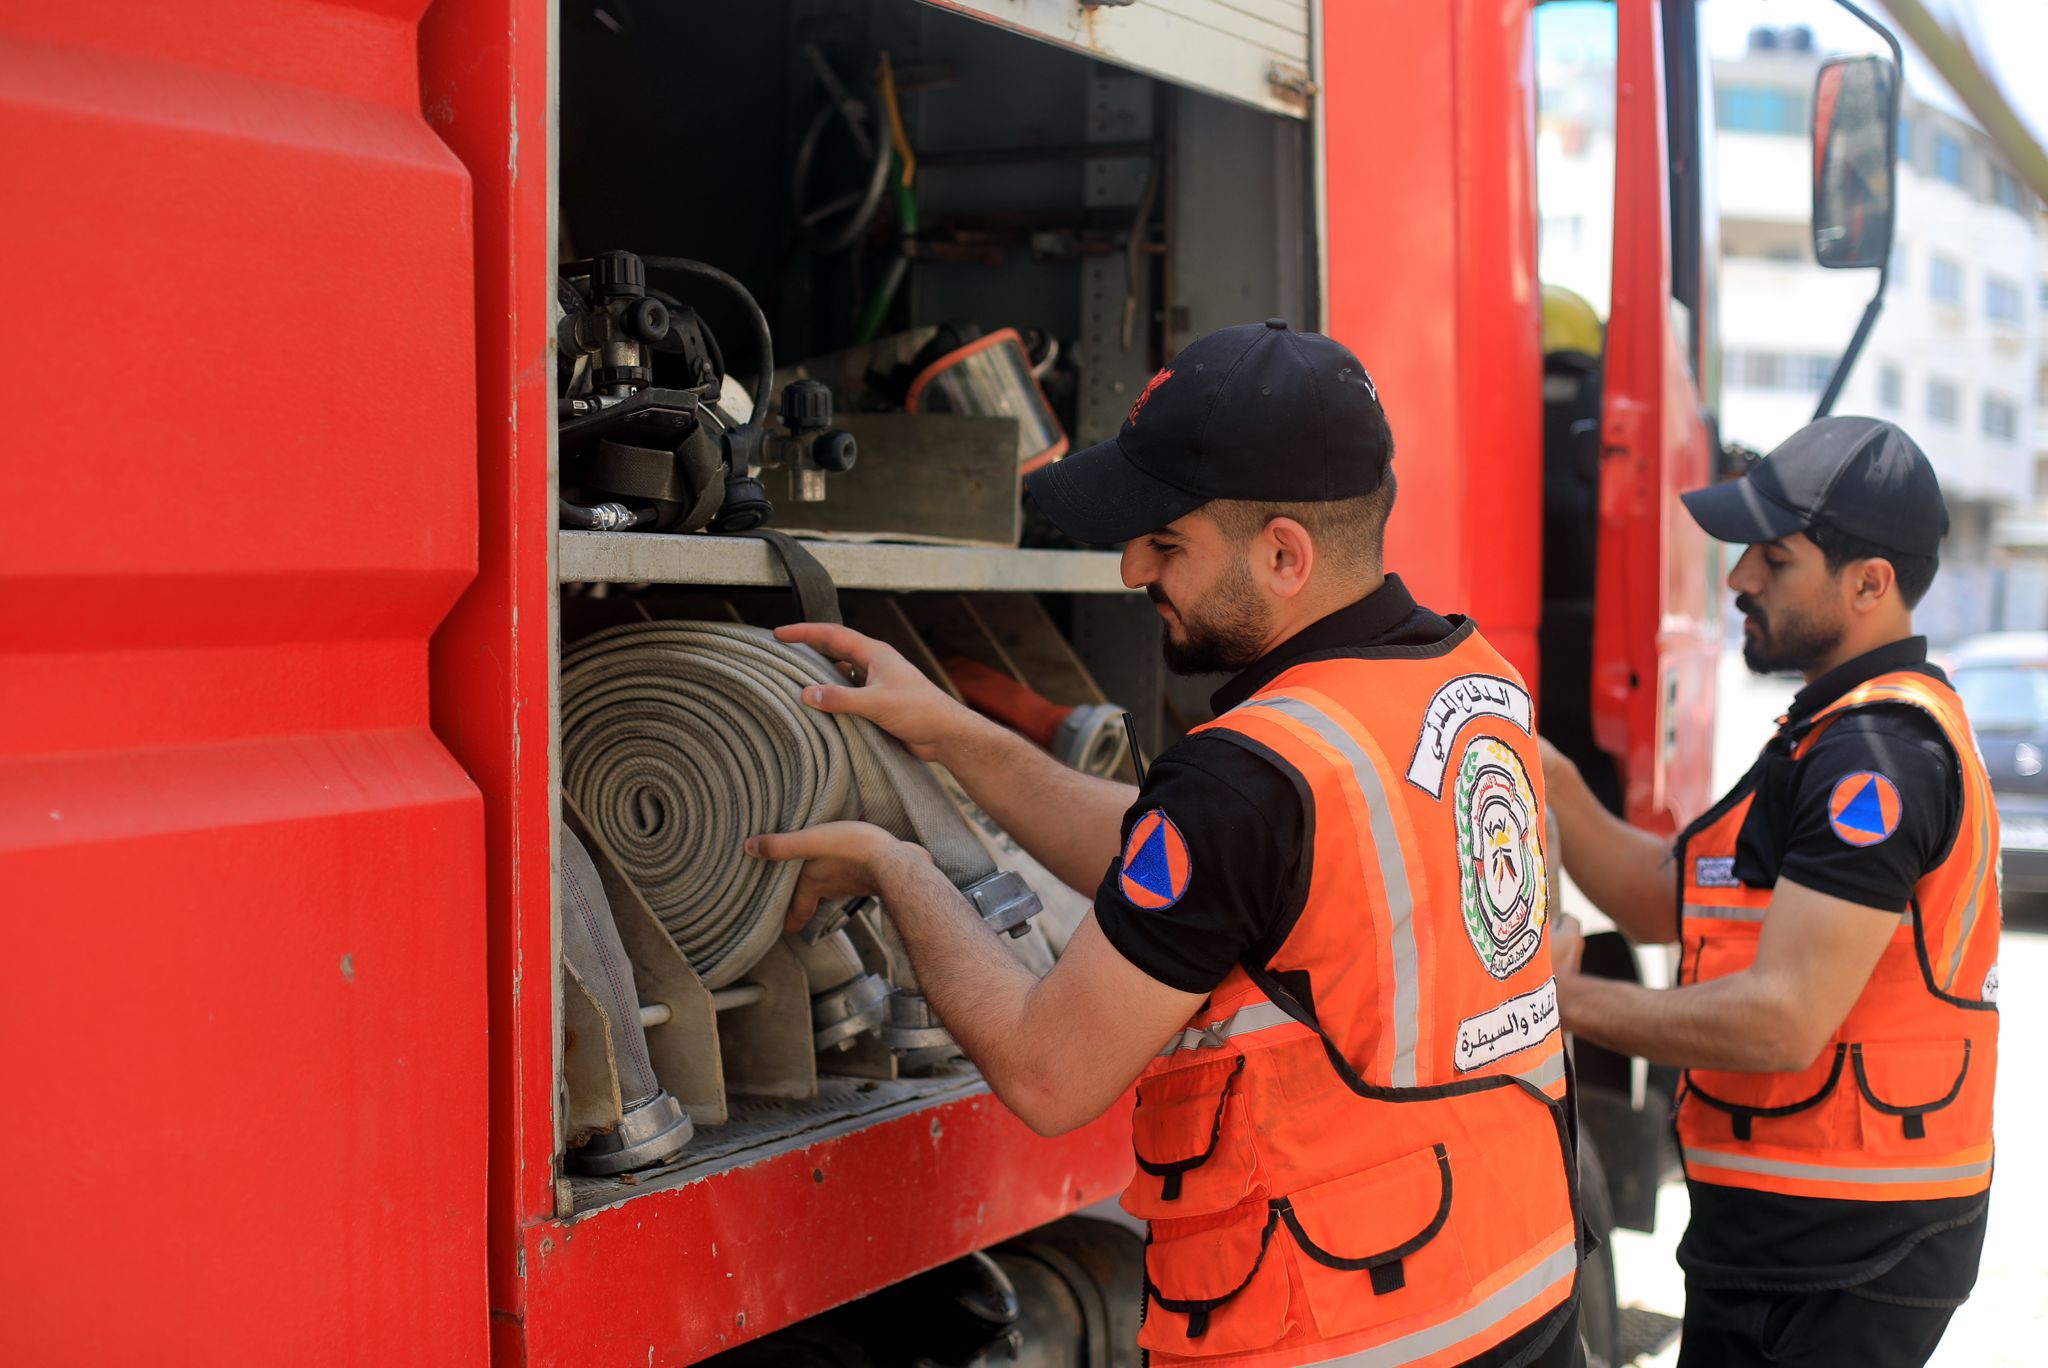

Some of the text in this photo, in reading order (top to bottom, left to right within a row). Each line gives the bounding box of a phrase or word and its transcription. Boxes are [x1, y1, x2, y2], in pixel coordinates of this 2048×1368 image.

[1427, 681, 1511, 763] الدفاع المدني
[1462, 1011, 1529, 1058] والسيطرة
